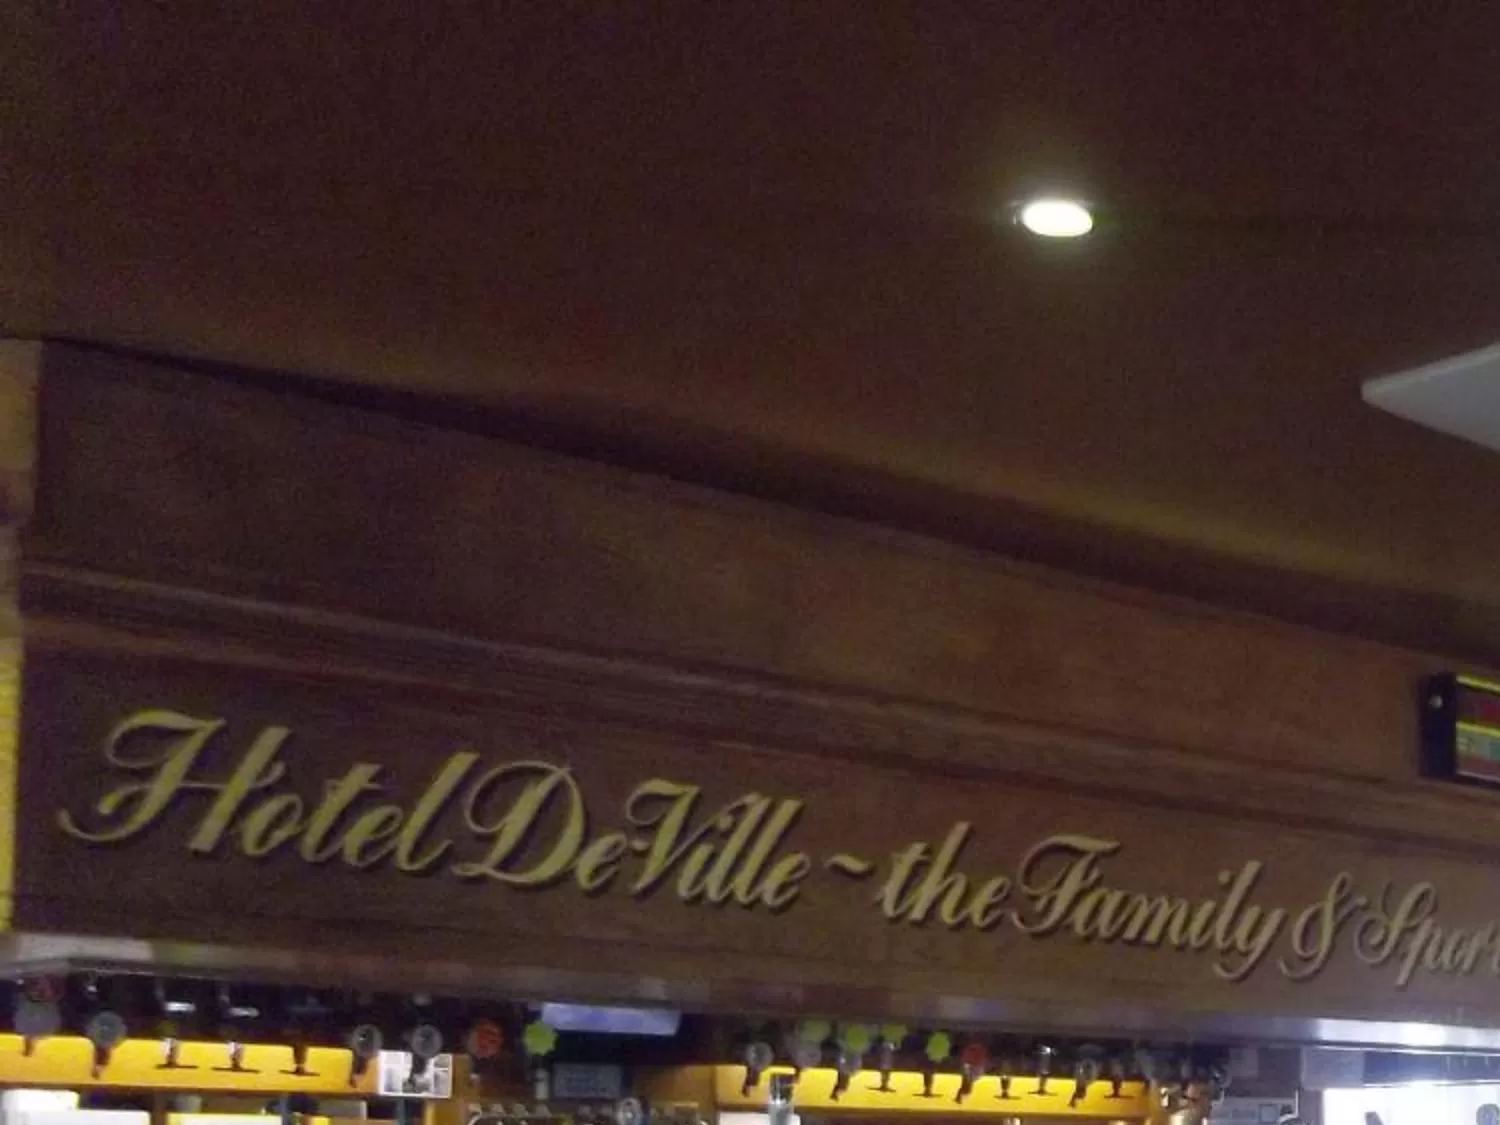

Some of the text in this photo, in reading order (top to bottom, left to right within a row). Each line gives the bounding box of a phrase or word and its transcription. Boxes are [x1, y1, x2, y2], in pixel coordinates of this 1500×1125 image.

[57, 709, 480, 872] Hotel
[878, 821, 1011, 928] the
[1011, 833, 1288, 980] Family
[1278, 871, 1368, 980] &
